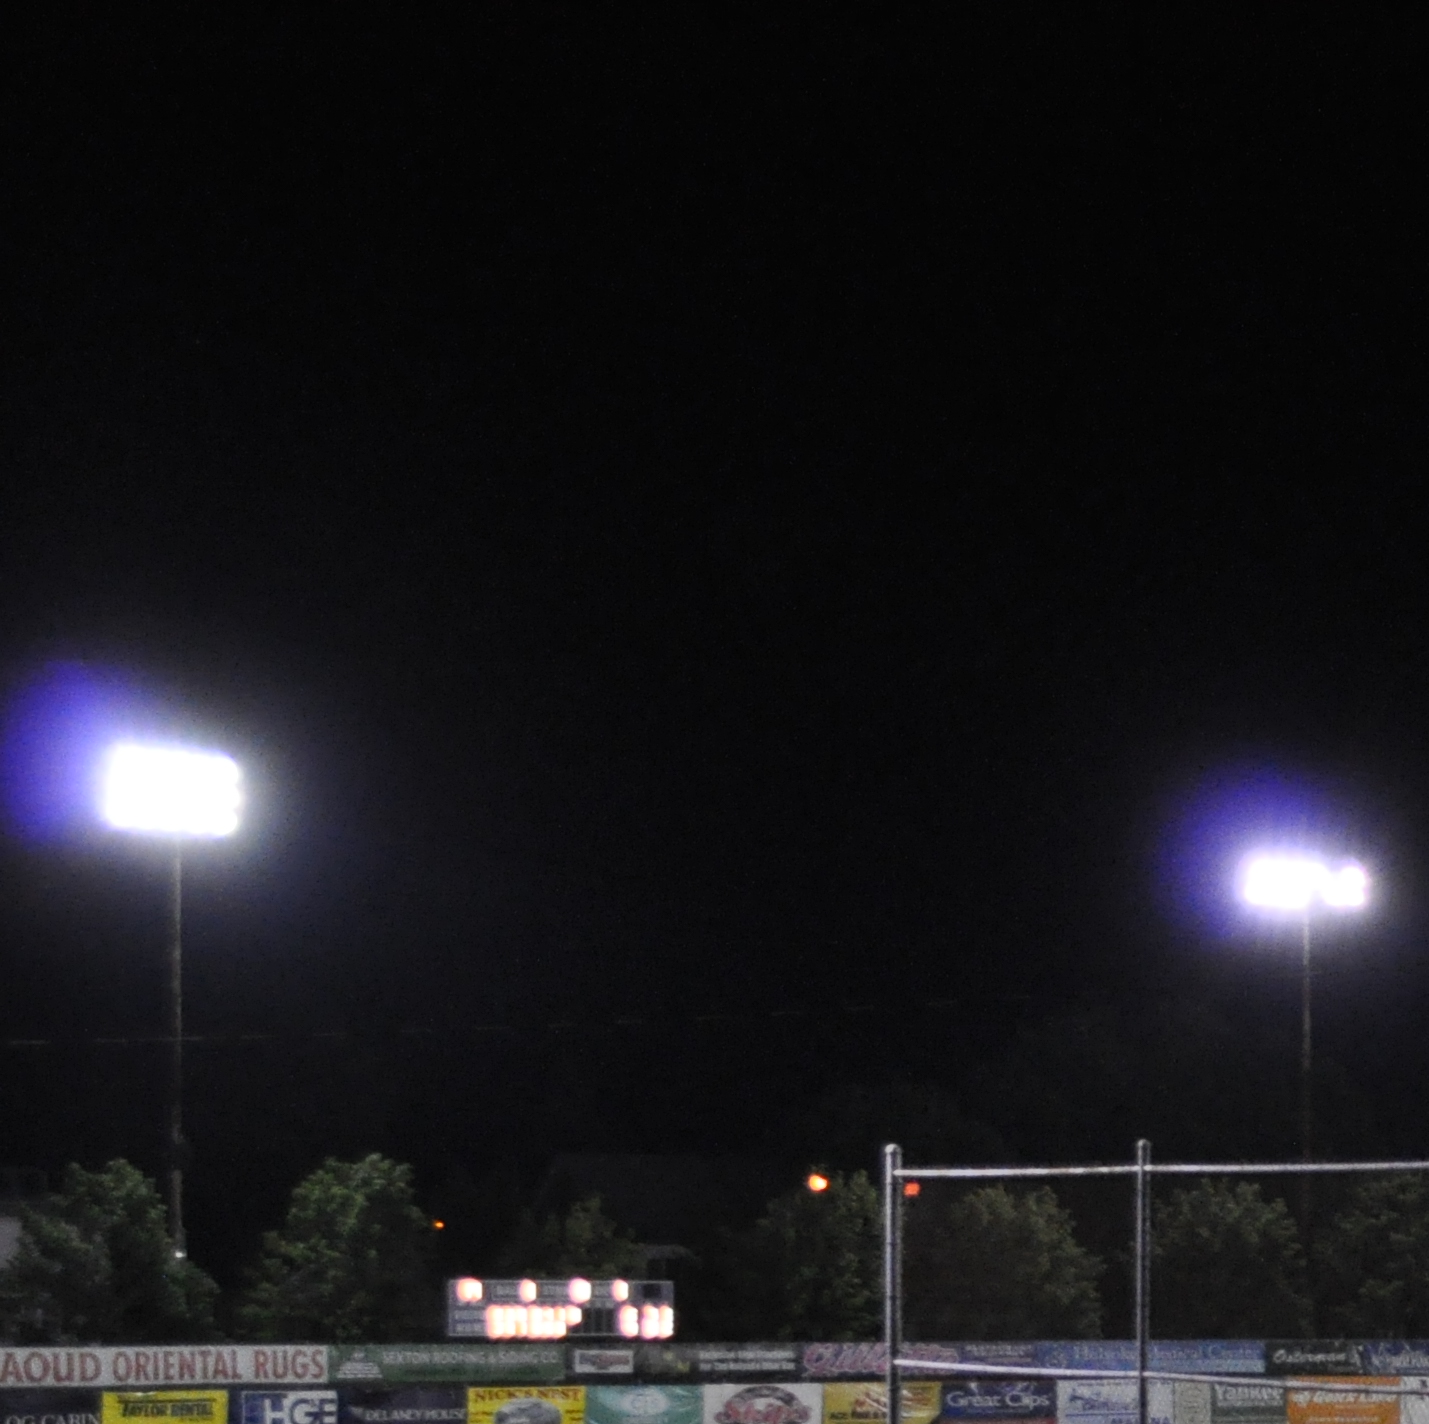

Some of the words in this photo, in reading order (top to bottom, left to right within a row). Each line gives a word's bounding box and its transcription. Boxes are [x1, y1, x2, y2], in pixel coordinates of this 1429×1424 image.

[112, 1350, 241, 1382] ORIENTAL
[254, 1349, 325, 1380] RUGS
[534, 1387, 580, 1401] NEST
[946, 1391, 1000, 1407] Great
[1005, 1391, 1049, 1410] Clips
[365, 1408, 421, 1421] DELANEY
